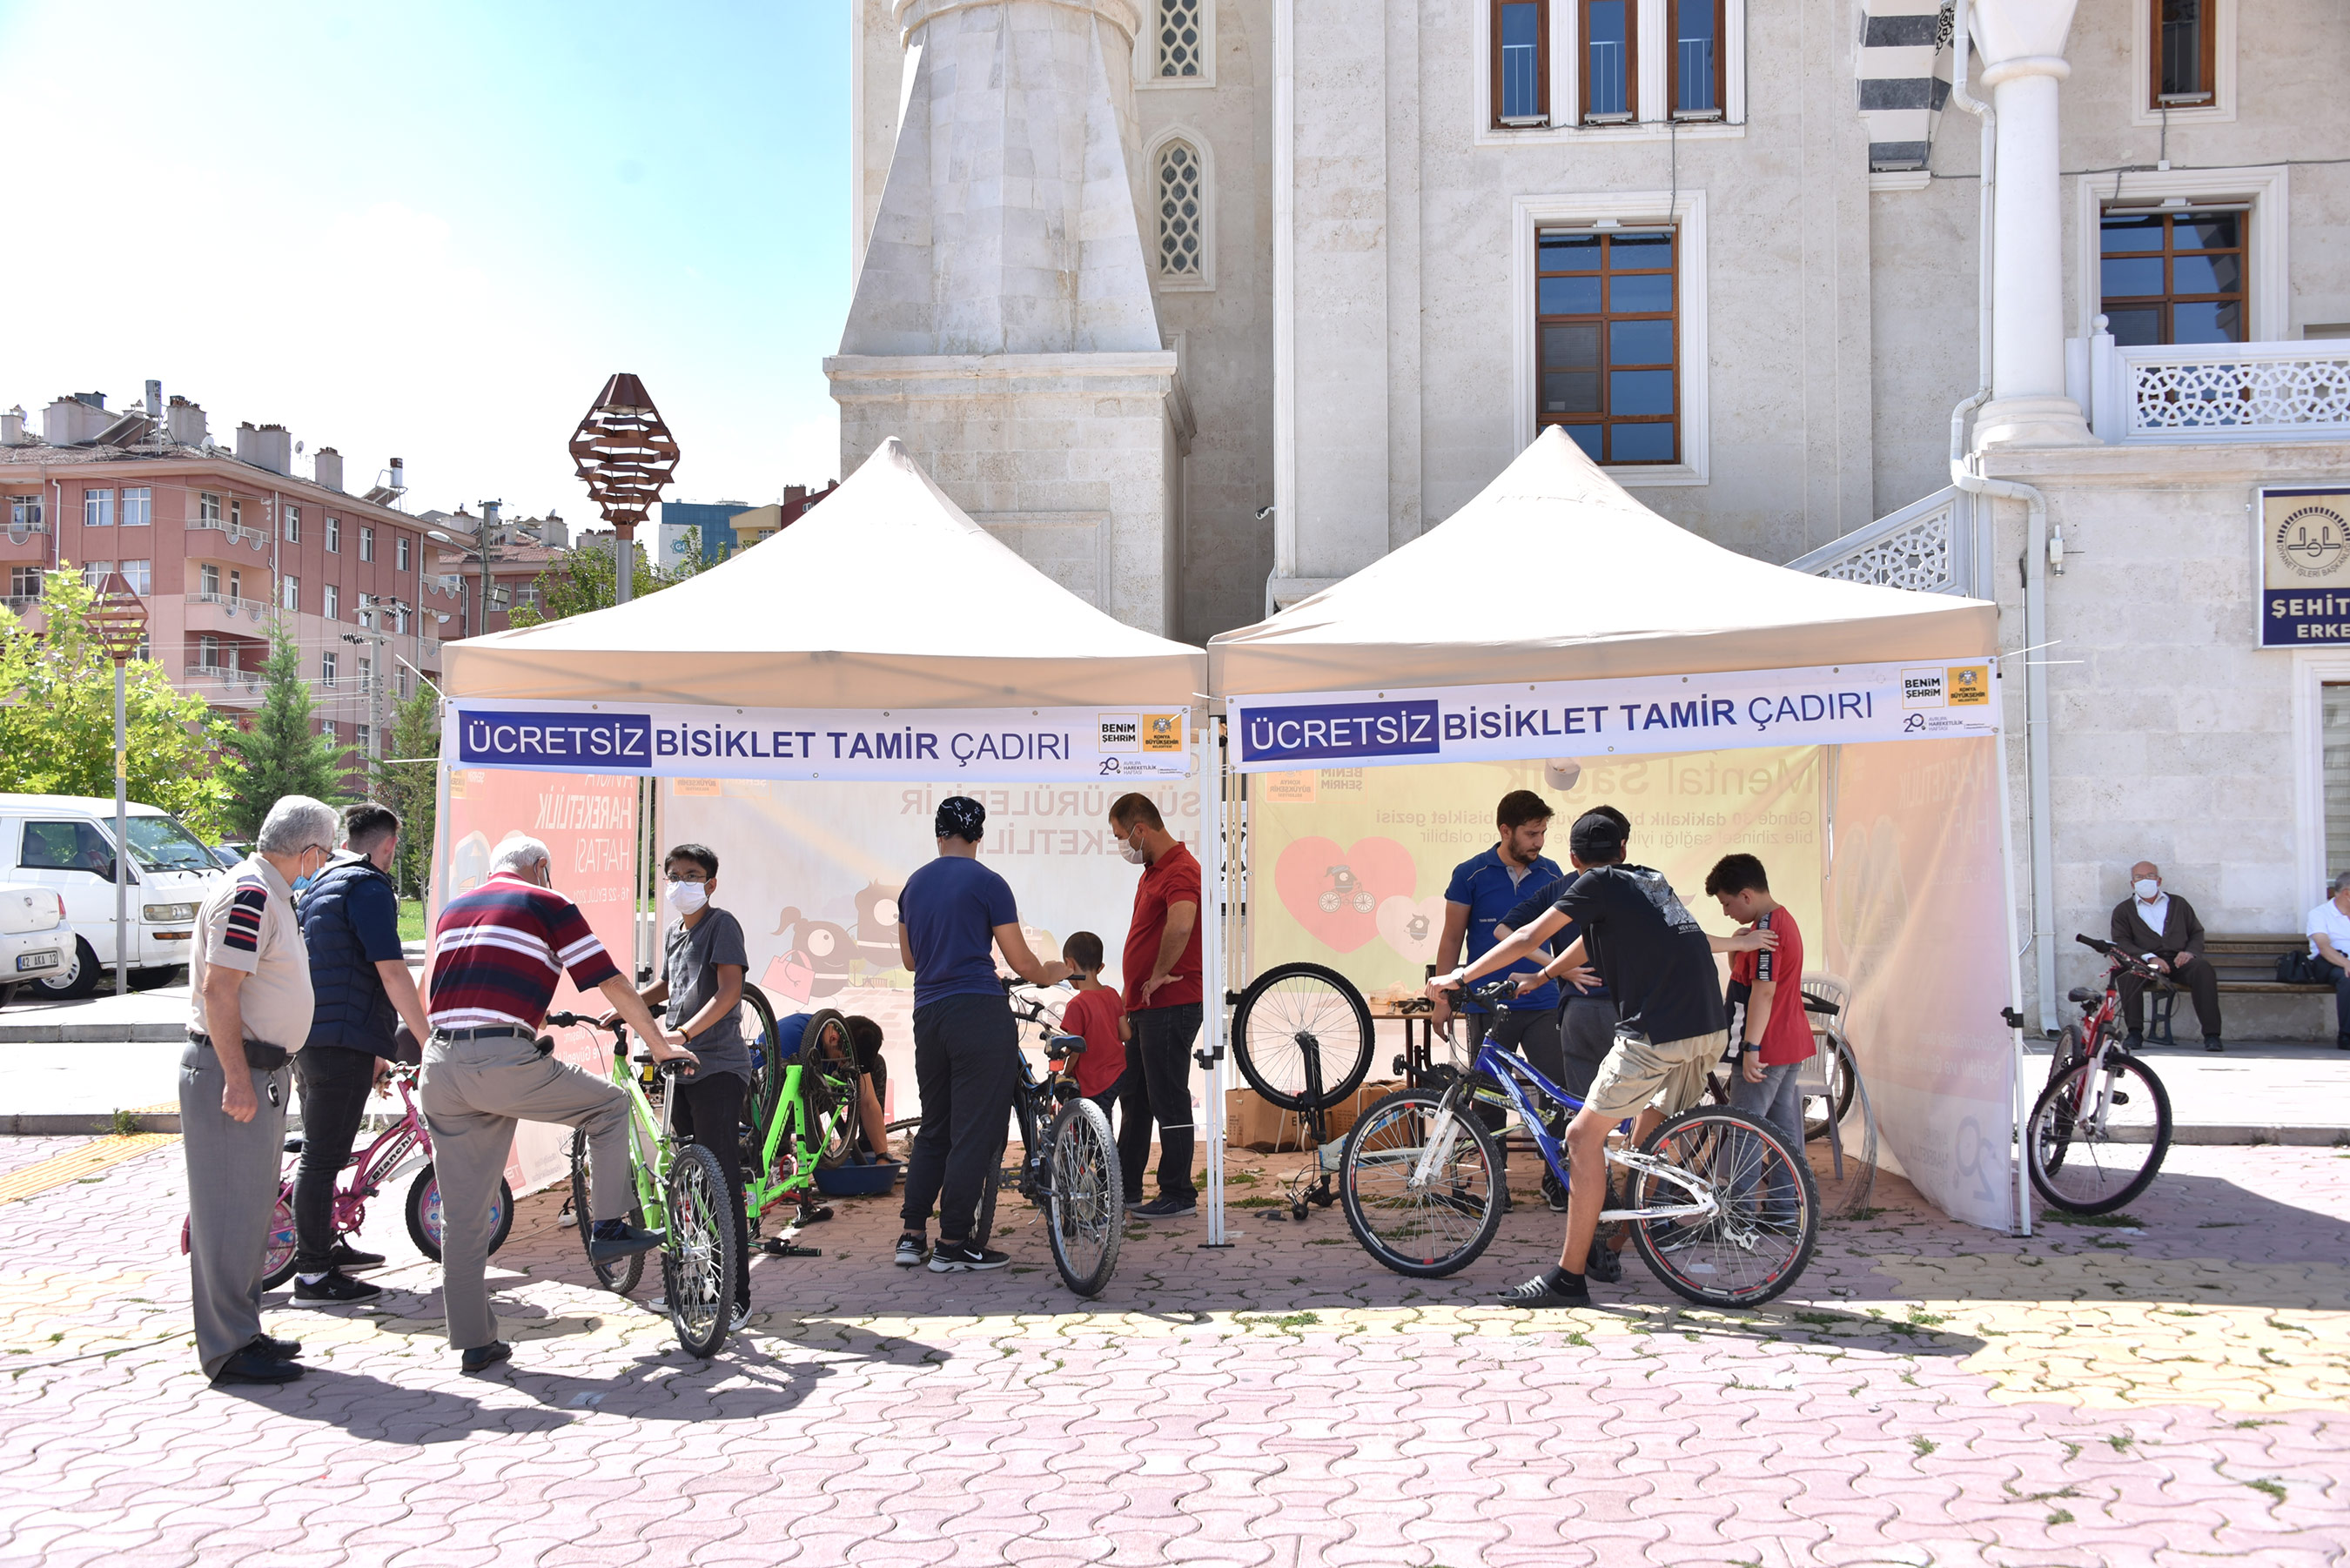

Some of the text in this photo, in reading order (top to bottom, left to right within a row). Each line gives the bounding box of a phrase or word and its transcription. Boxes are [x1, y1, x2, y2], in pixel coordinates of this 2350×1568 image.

[468, 720, 1070, 767] ÜCRETSİZ BİSİKLET TAMİR ÇADIRI
[1250, 691, 1873, 750] ÜCRETSİZ BİSİKLET TAMİR ÇADIRI
[22, 958, 30, 968] 42
[49, 953, 57, 963] 12
[372, 1135, 413, 1181] Bianchi
